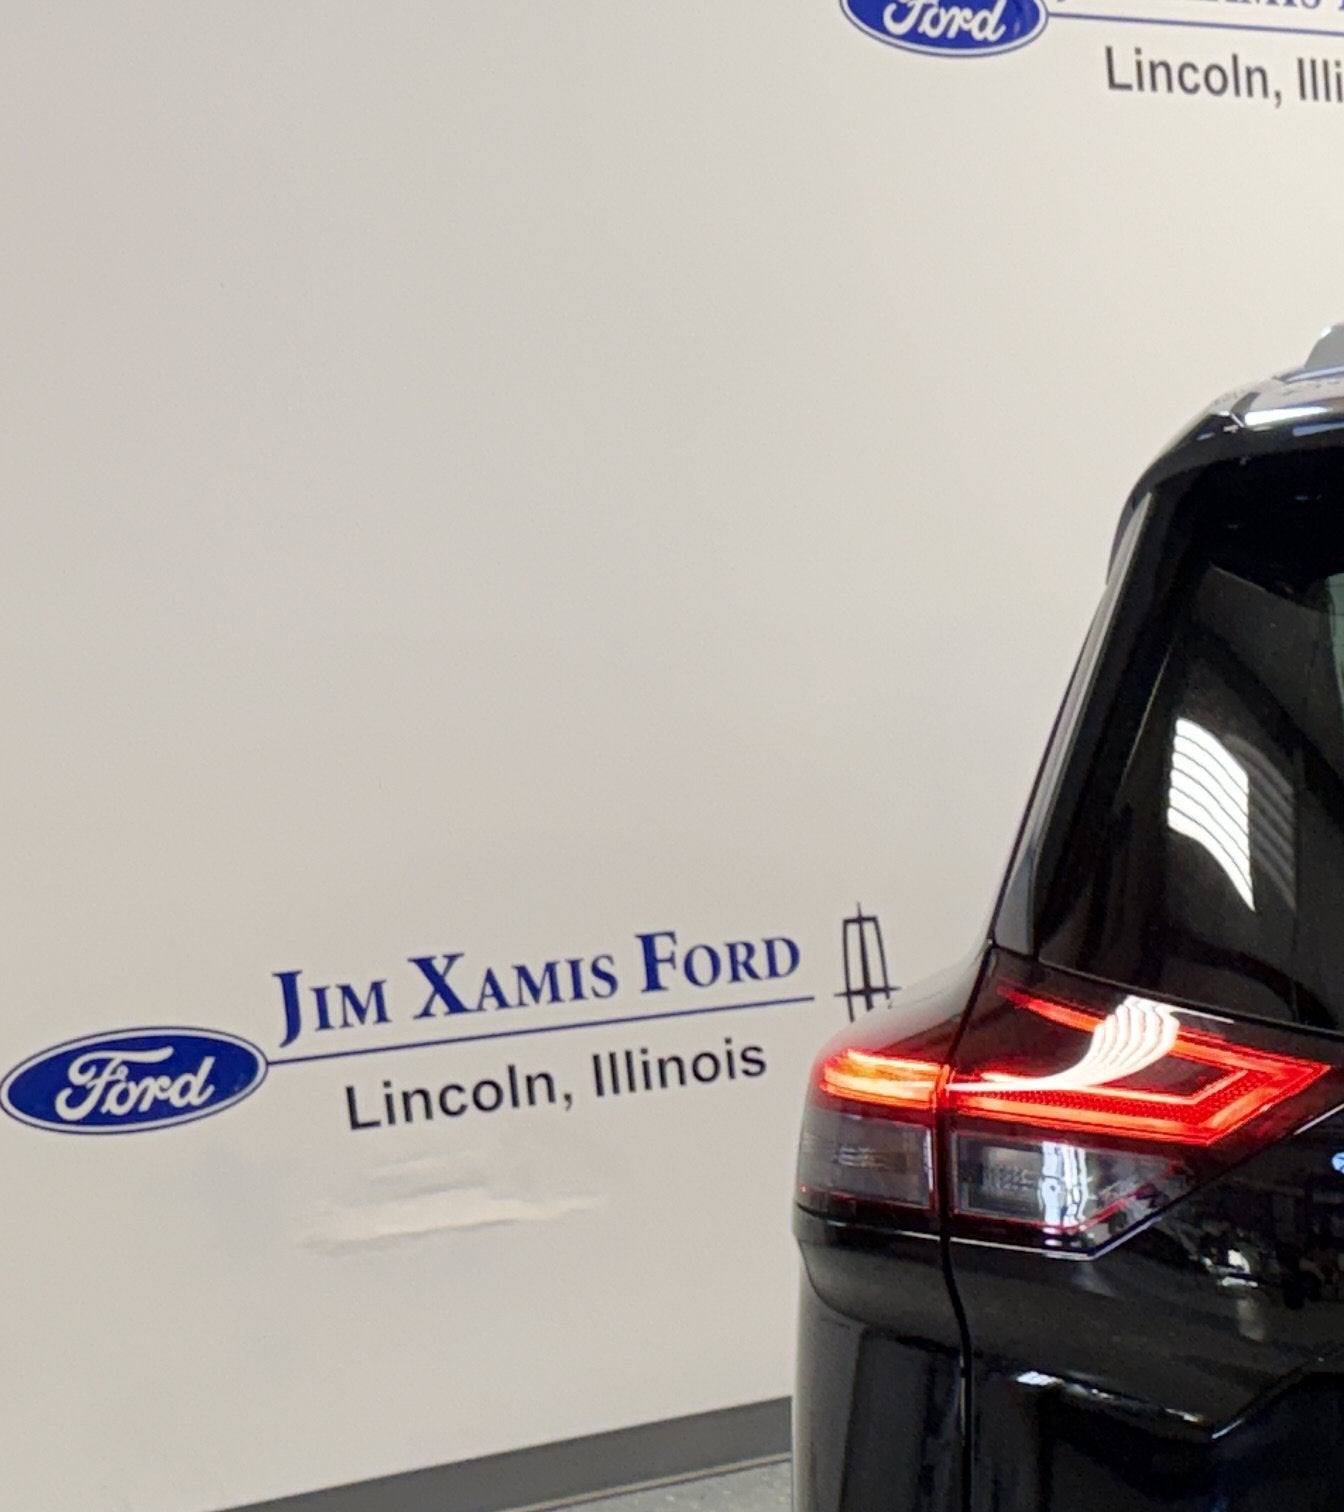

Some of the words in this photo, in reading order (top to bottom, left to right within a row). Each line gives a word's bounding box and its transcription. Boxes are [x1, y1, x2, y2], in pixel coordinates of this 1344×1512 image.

[1104, 46, 1284, 107] Lincoln,
[272, 970, 391, 1046] JIM
[409, 952, 619, 1020] XAMIS
[634, 930, 801, 993] FORD
[55, 1047, 217, 1121] Ford
[345, 1063, 574, 1131] Lincoln,
[592, 1036, 767, 1097] Illinois
